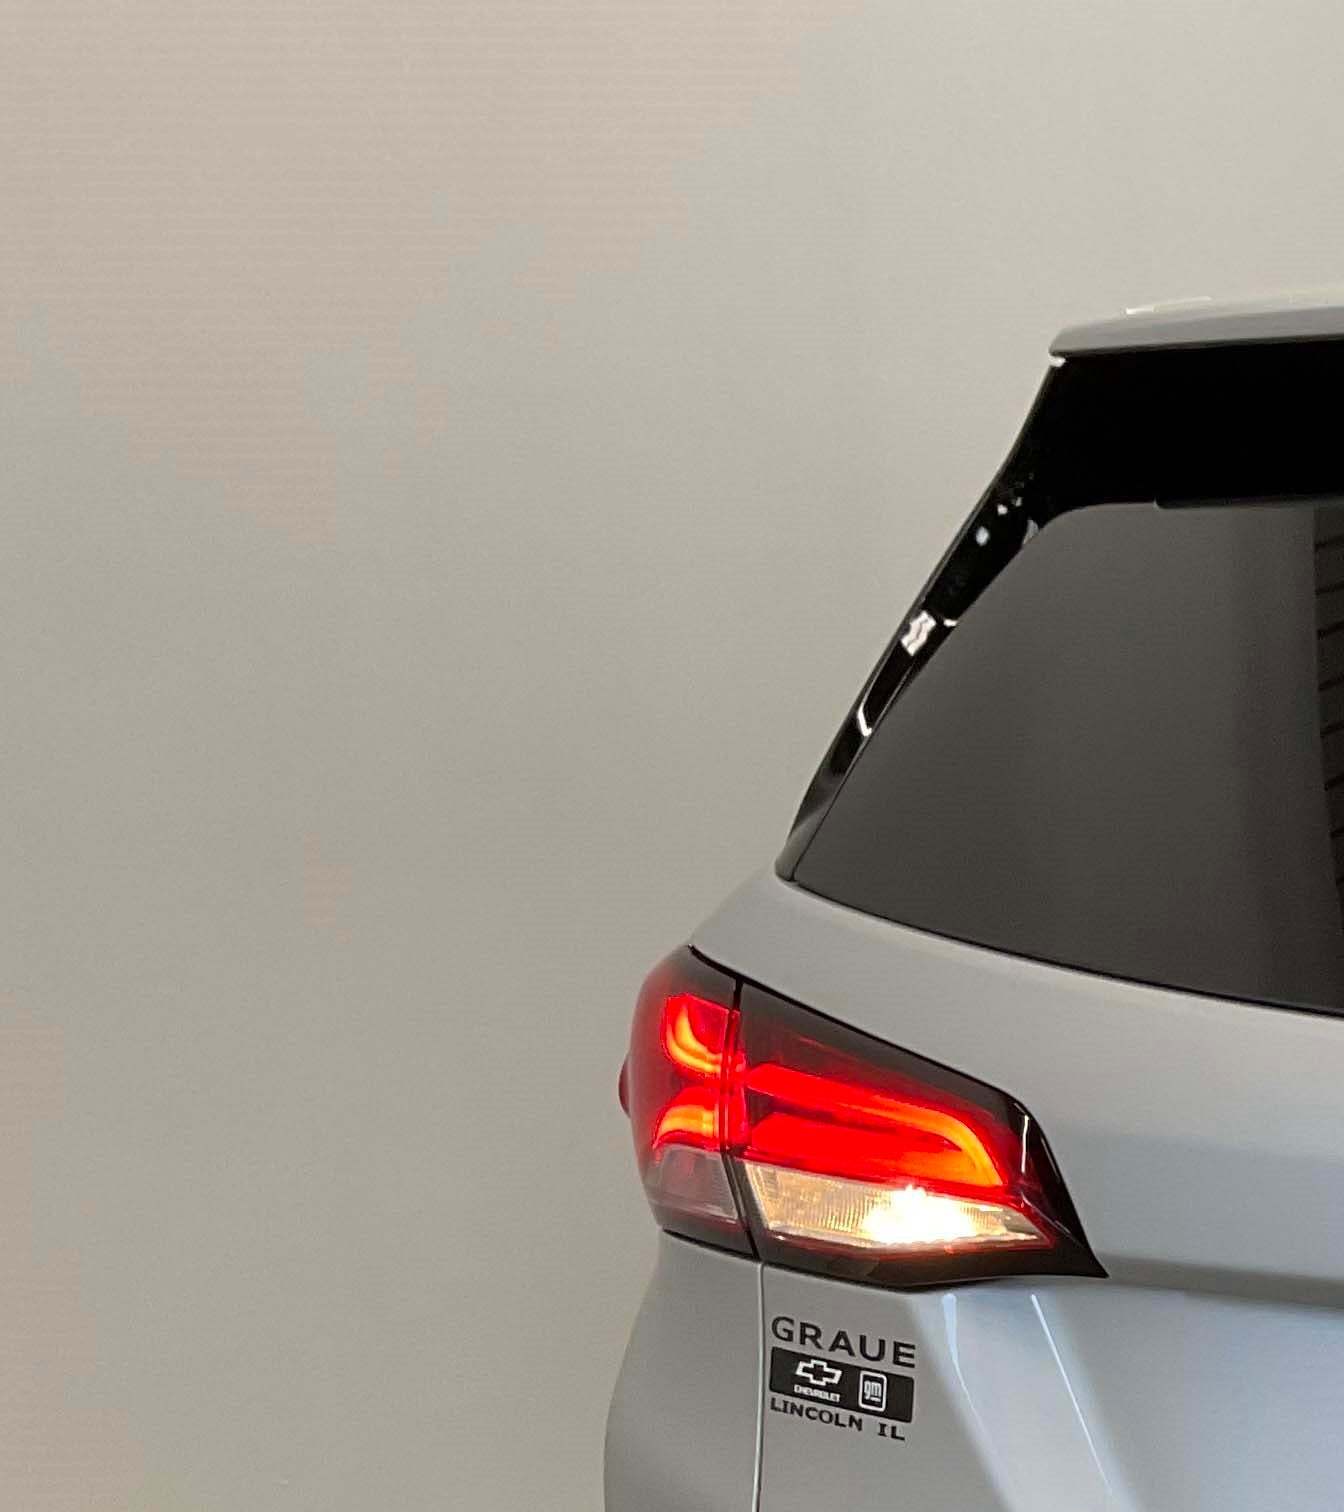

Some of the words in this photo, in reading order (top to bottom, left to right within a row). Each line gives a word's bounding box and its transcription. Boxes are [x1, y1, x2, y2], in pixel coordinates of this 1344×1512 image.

[771, 1316, 916, 1368] GRAUE
[863, 1380, 883, 1403] gm
[878, 1422, 906, 1441] IL
